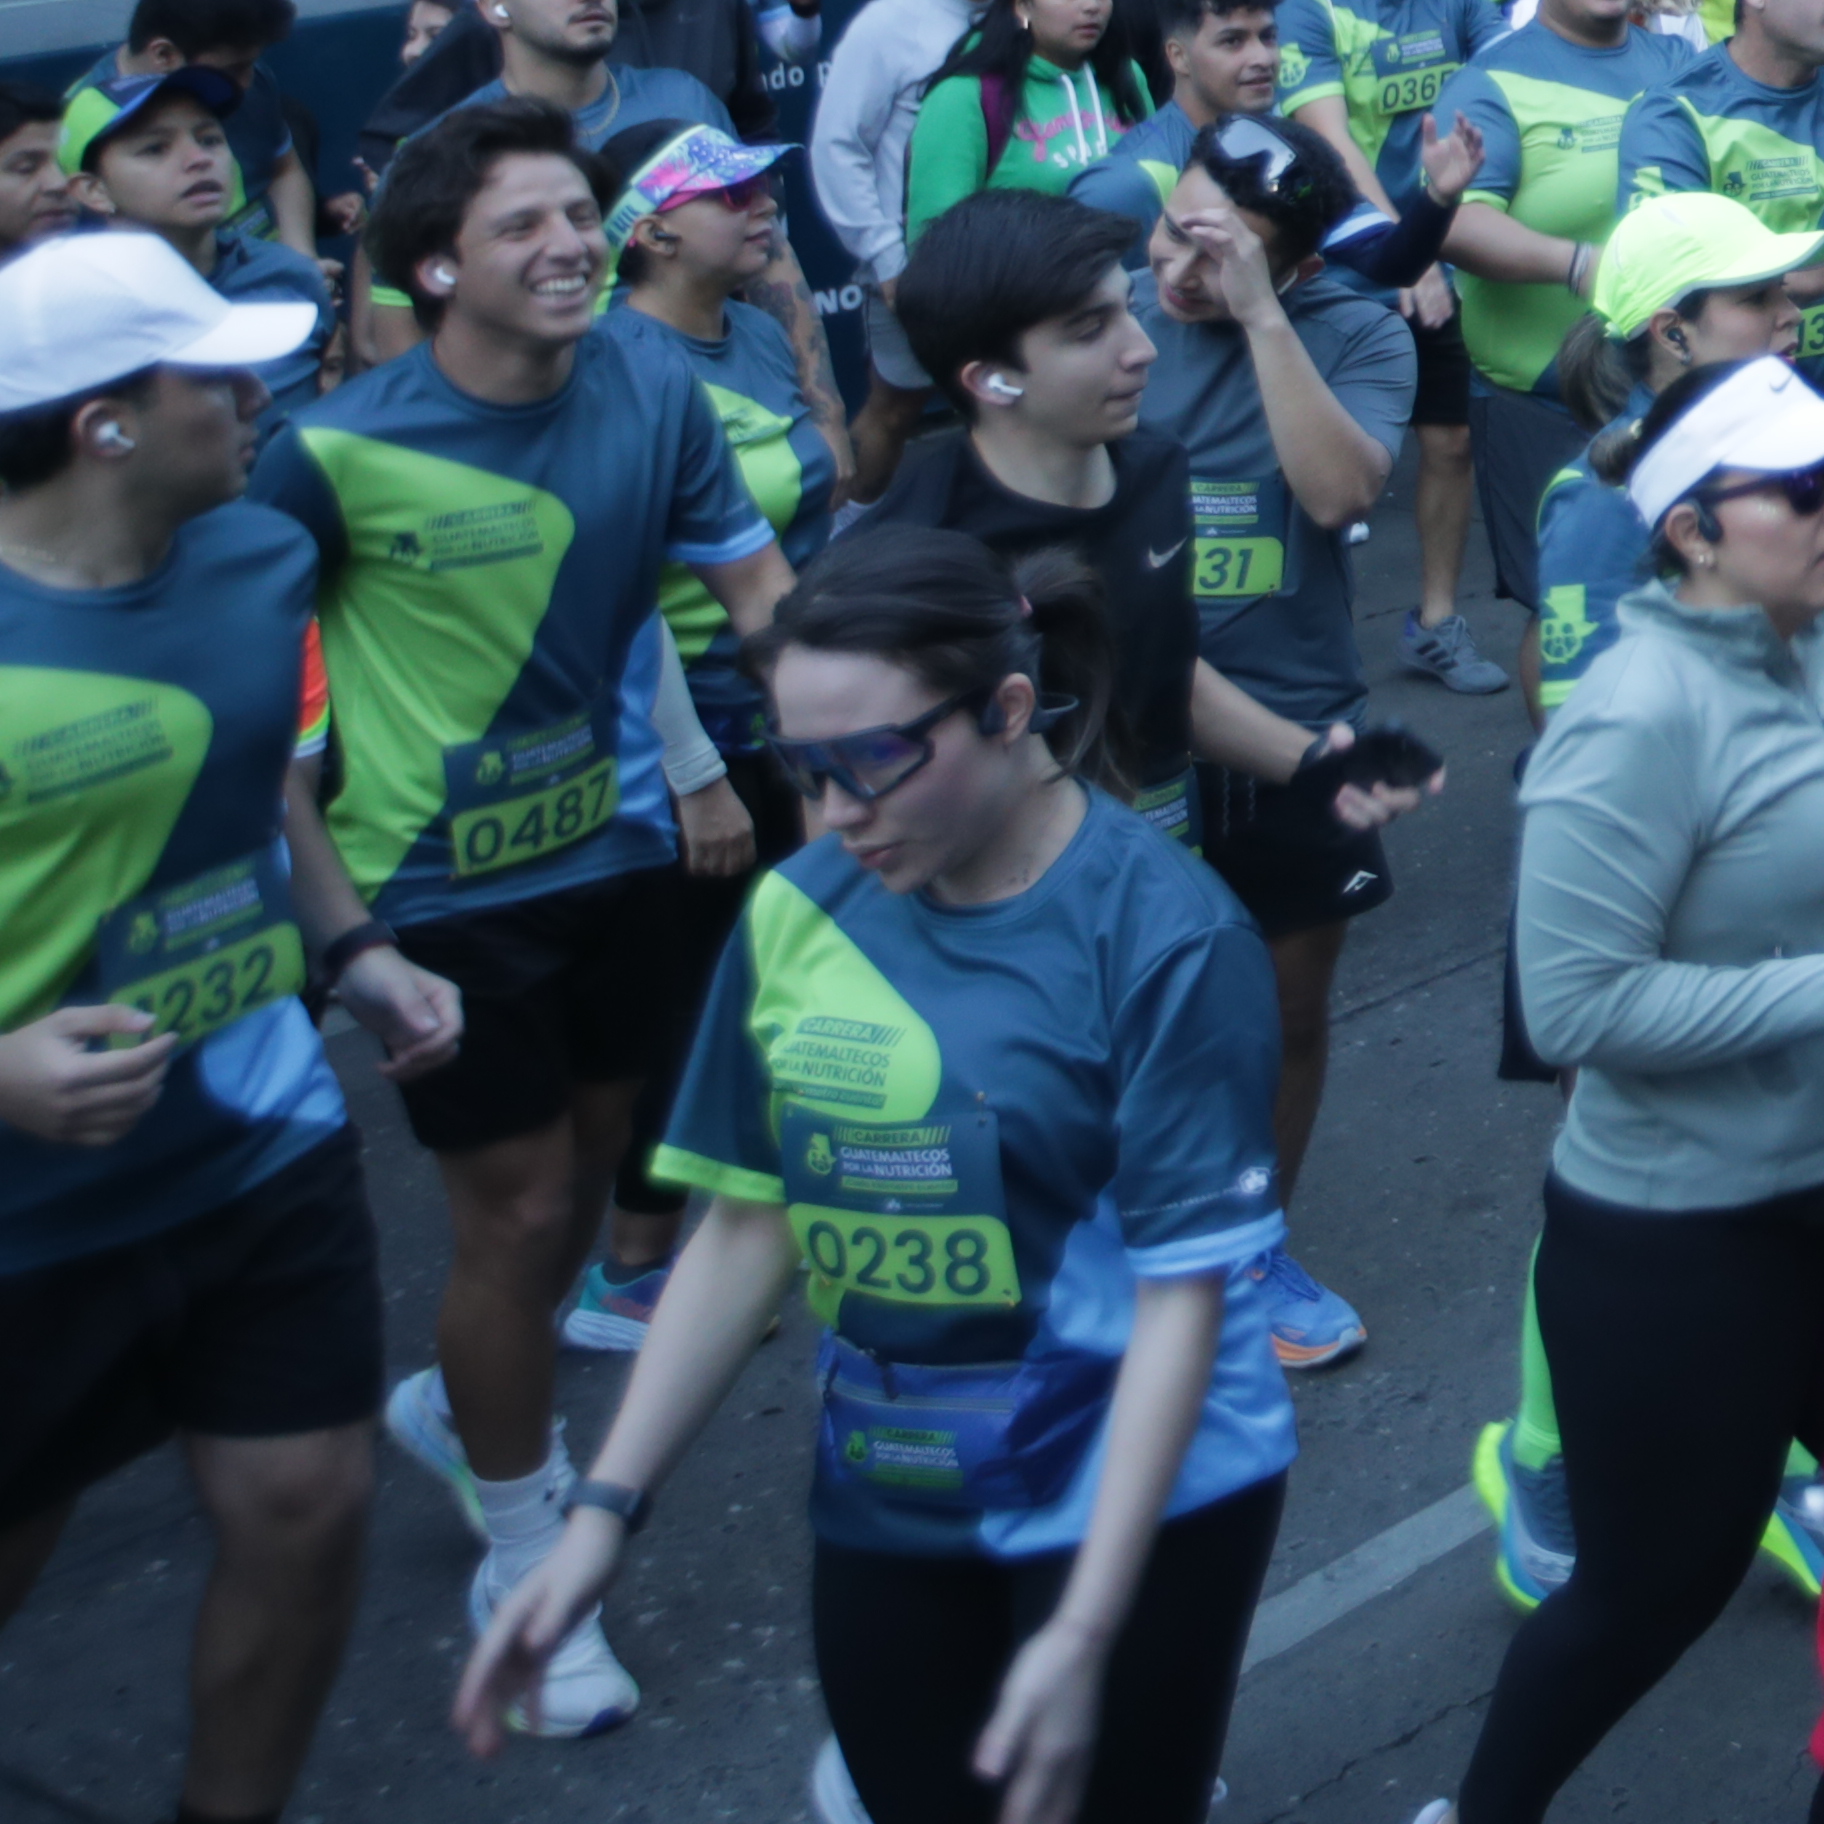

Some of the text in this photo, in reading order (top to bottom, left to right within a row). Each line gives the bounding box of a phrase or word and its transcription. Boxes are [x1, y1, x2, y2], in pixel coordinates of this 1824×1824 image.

[1198, 546, 1254, 590] 31
[464, 766, 614, 866] 0487
[800, 1058, 887, 1088] NUTRICIÓN
[853, 1128, 922, 1144] CARRERA
[839, 1146, 951, 1163] GUATEMALTECOS
[842, 1162, 860, 1173] POR
[874, 1160, 953, 1177] NUTRICIÓN
[807, 1219, 991, 1296] 0238
